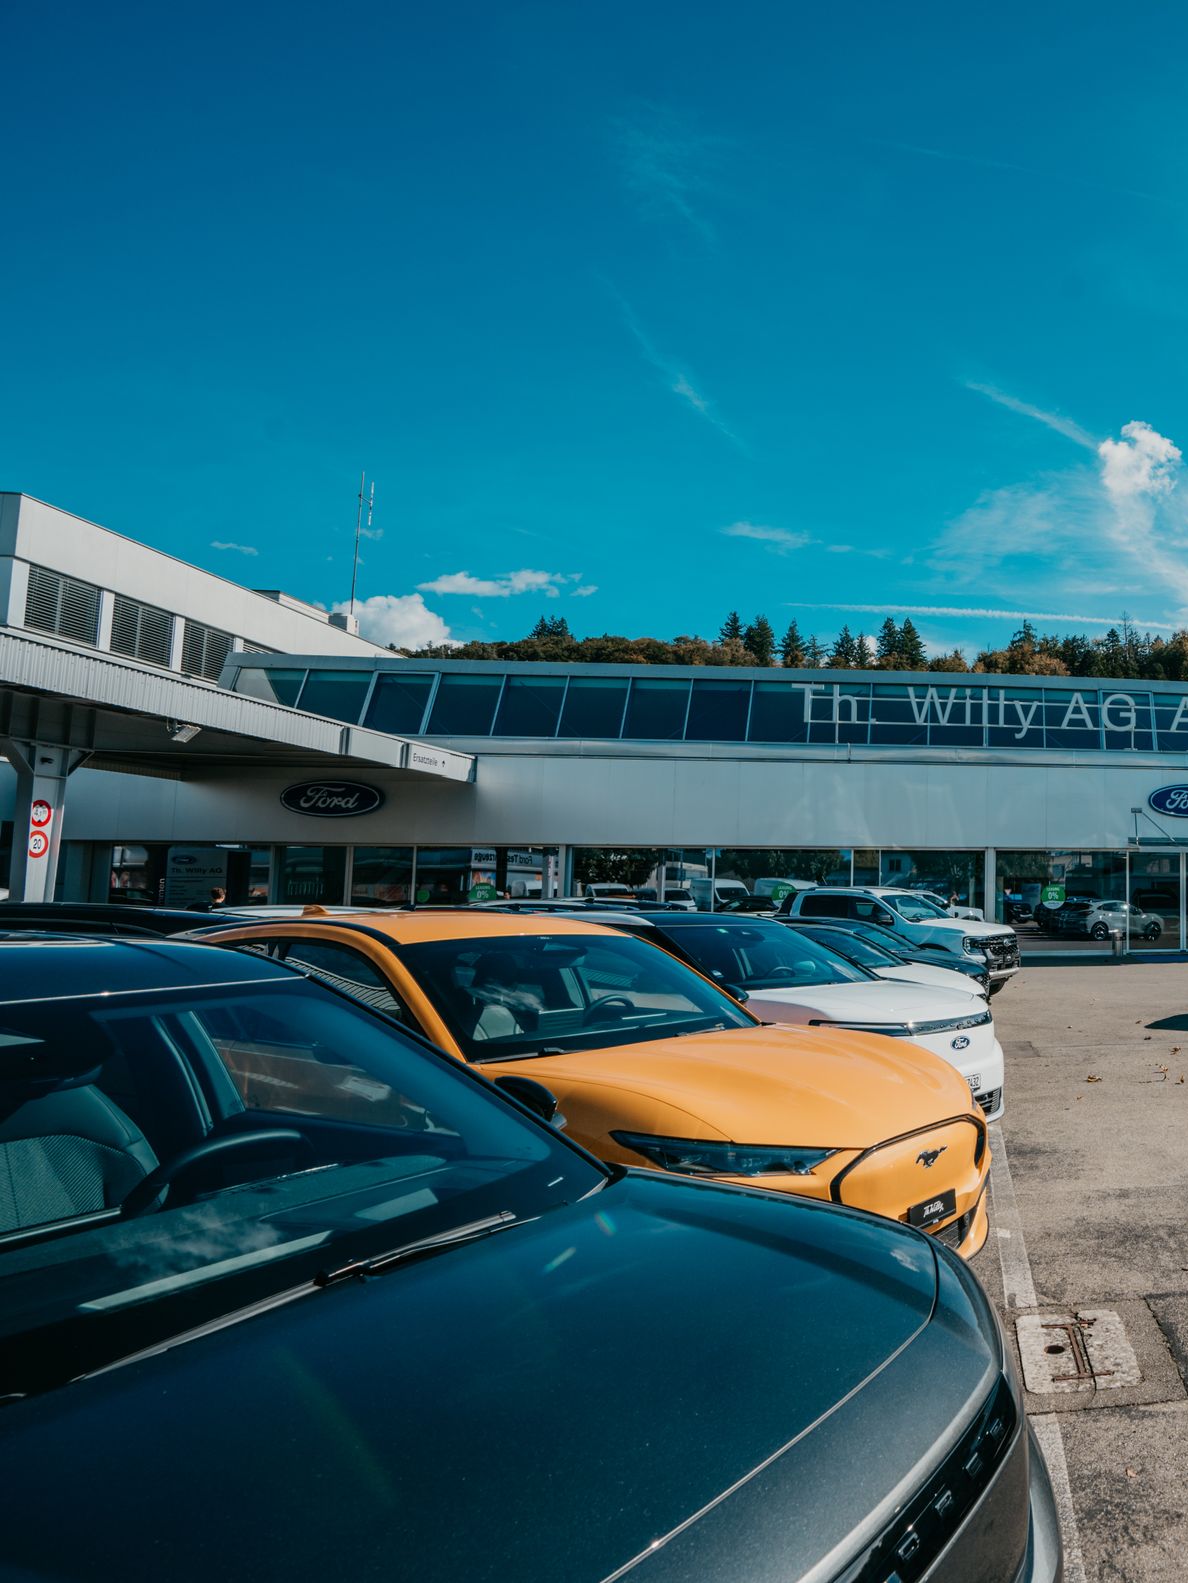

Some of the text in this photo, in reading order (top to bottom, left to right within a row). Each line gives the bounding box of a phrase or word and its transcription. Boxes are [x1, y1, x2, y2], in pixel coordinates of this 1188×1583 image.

[792, 684, 876, 723] Th.
[907, 687, 1038, 739] Willy
[1061, 692, 1136, 732] AG
[413, 752, 438, 767] Ersatzteile
[300, 786, 360, 809] Ford
[33, 838, 42, 850] 20
[476, 890, 489, 899] 0%
